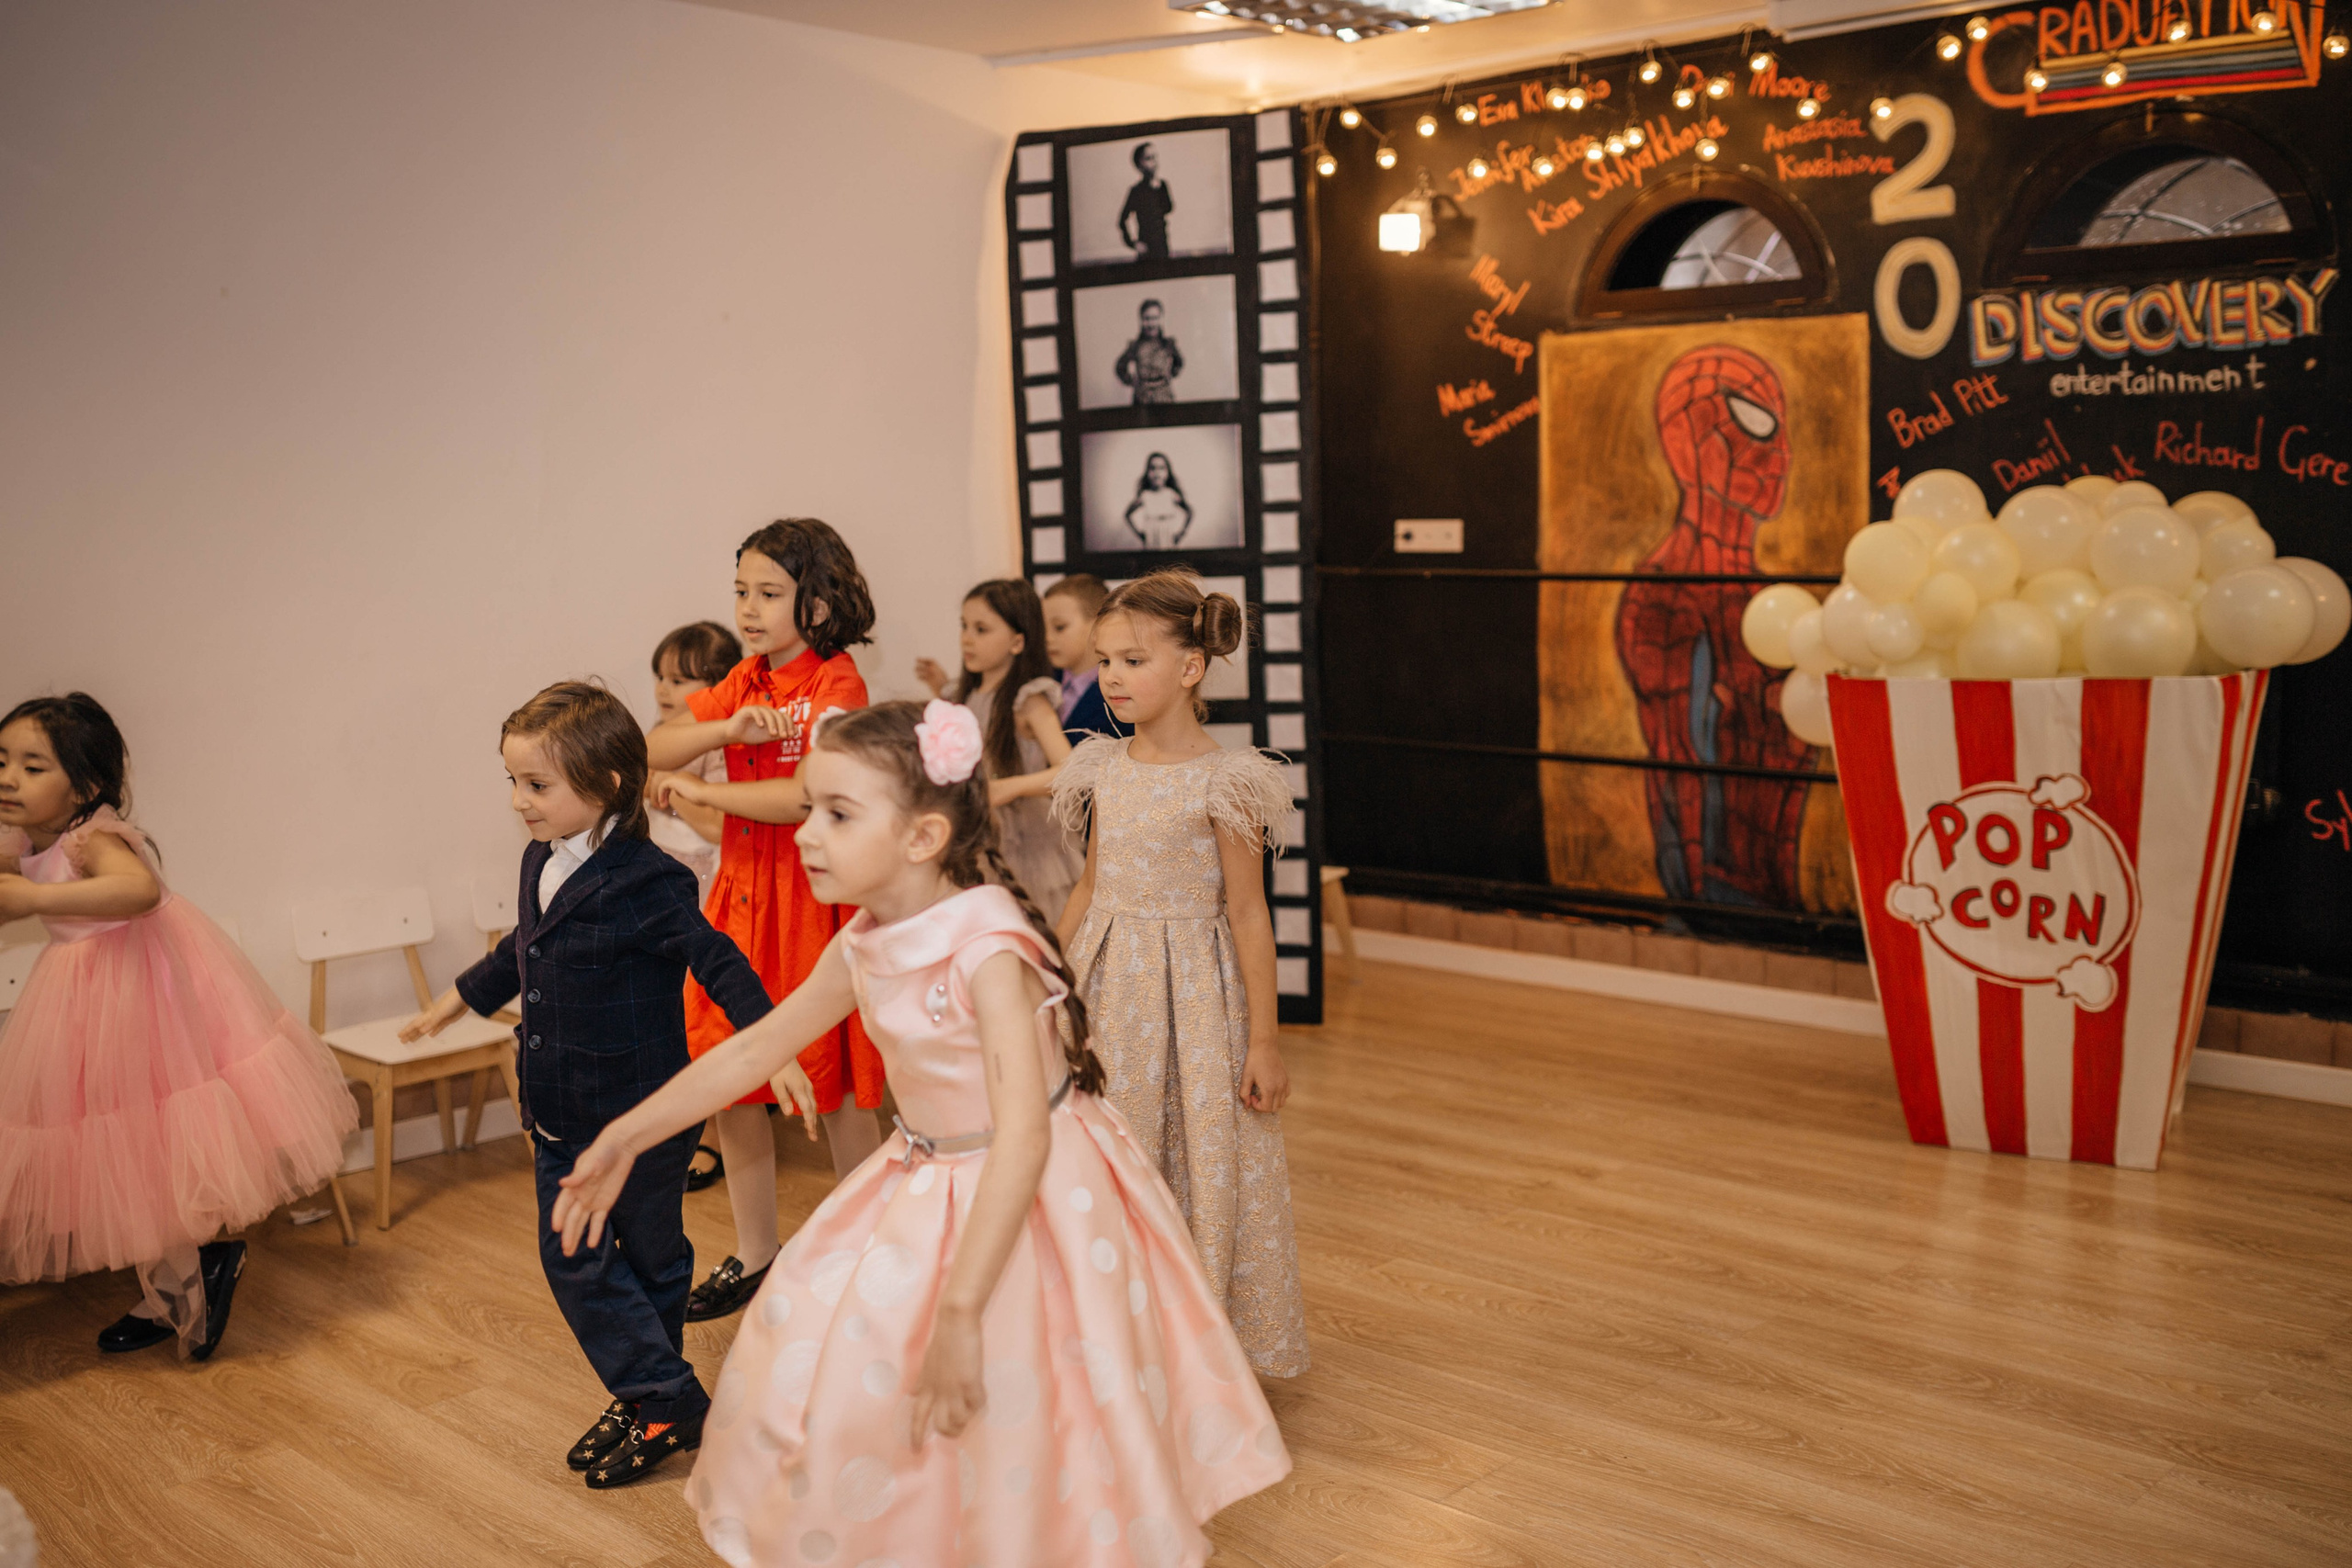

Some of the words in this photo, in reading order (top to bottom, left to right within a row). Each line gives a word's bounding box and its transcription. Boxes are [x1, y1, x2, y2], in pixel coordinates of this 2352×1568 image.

[1748, 61, 1832, 104] Moore
[1971, 267, 2339, 367] DISCOVERY
[1887, 389, 1955, 450] Brad
[1952, 372, 2009, 417] Pitt
[2049, 355, 2267, 399] entertainment
[2154, 415, 2266, 471] Richard
[2278, 424, 2352, 487] Gere
[1927, 802, 2074, 872] POP
[1950, 878, 2108, 946] CORN
